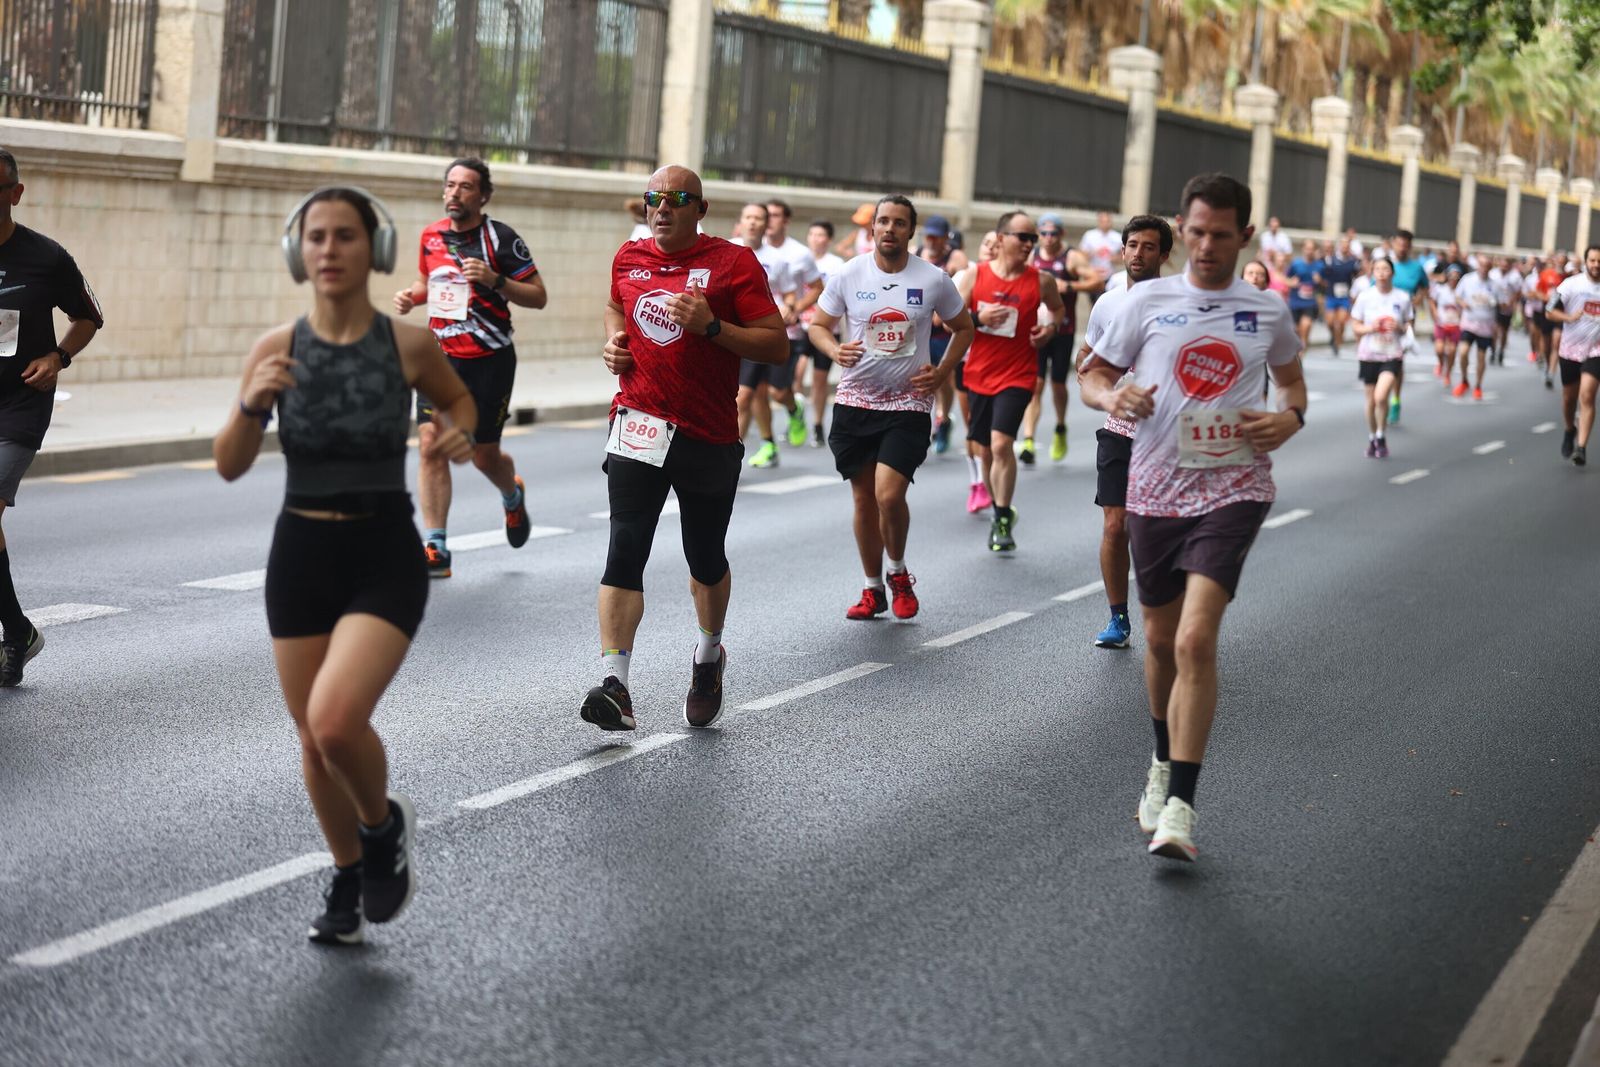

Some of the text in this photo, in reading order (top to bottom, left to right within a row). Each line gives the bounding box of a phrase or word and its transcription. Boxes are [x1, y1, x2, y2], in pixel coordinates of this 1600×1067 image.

[440, 292, 455, 302] 52
[643, 301, 670, 319] PONL
[640, 310, 676, 332] FRENO
[878, 331, 905, 342] 281
[625, 421, 657, 439] 980
[1191, 423, 1243, 440] 1182
